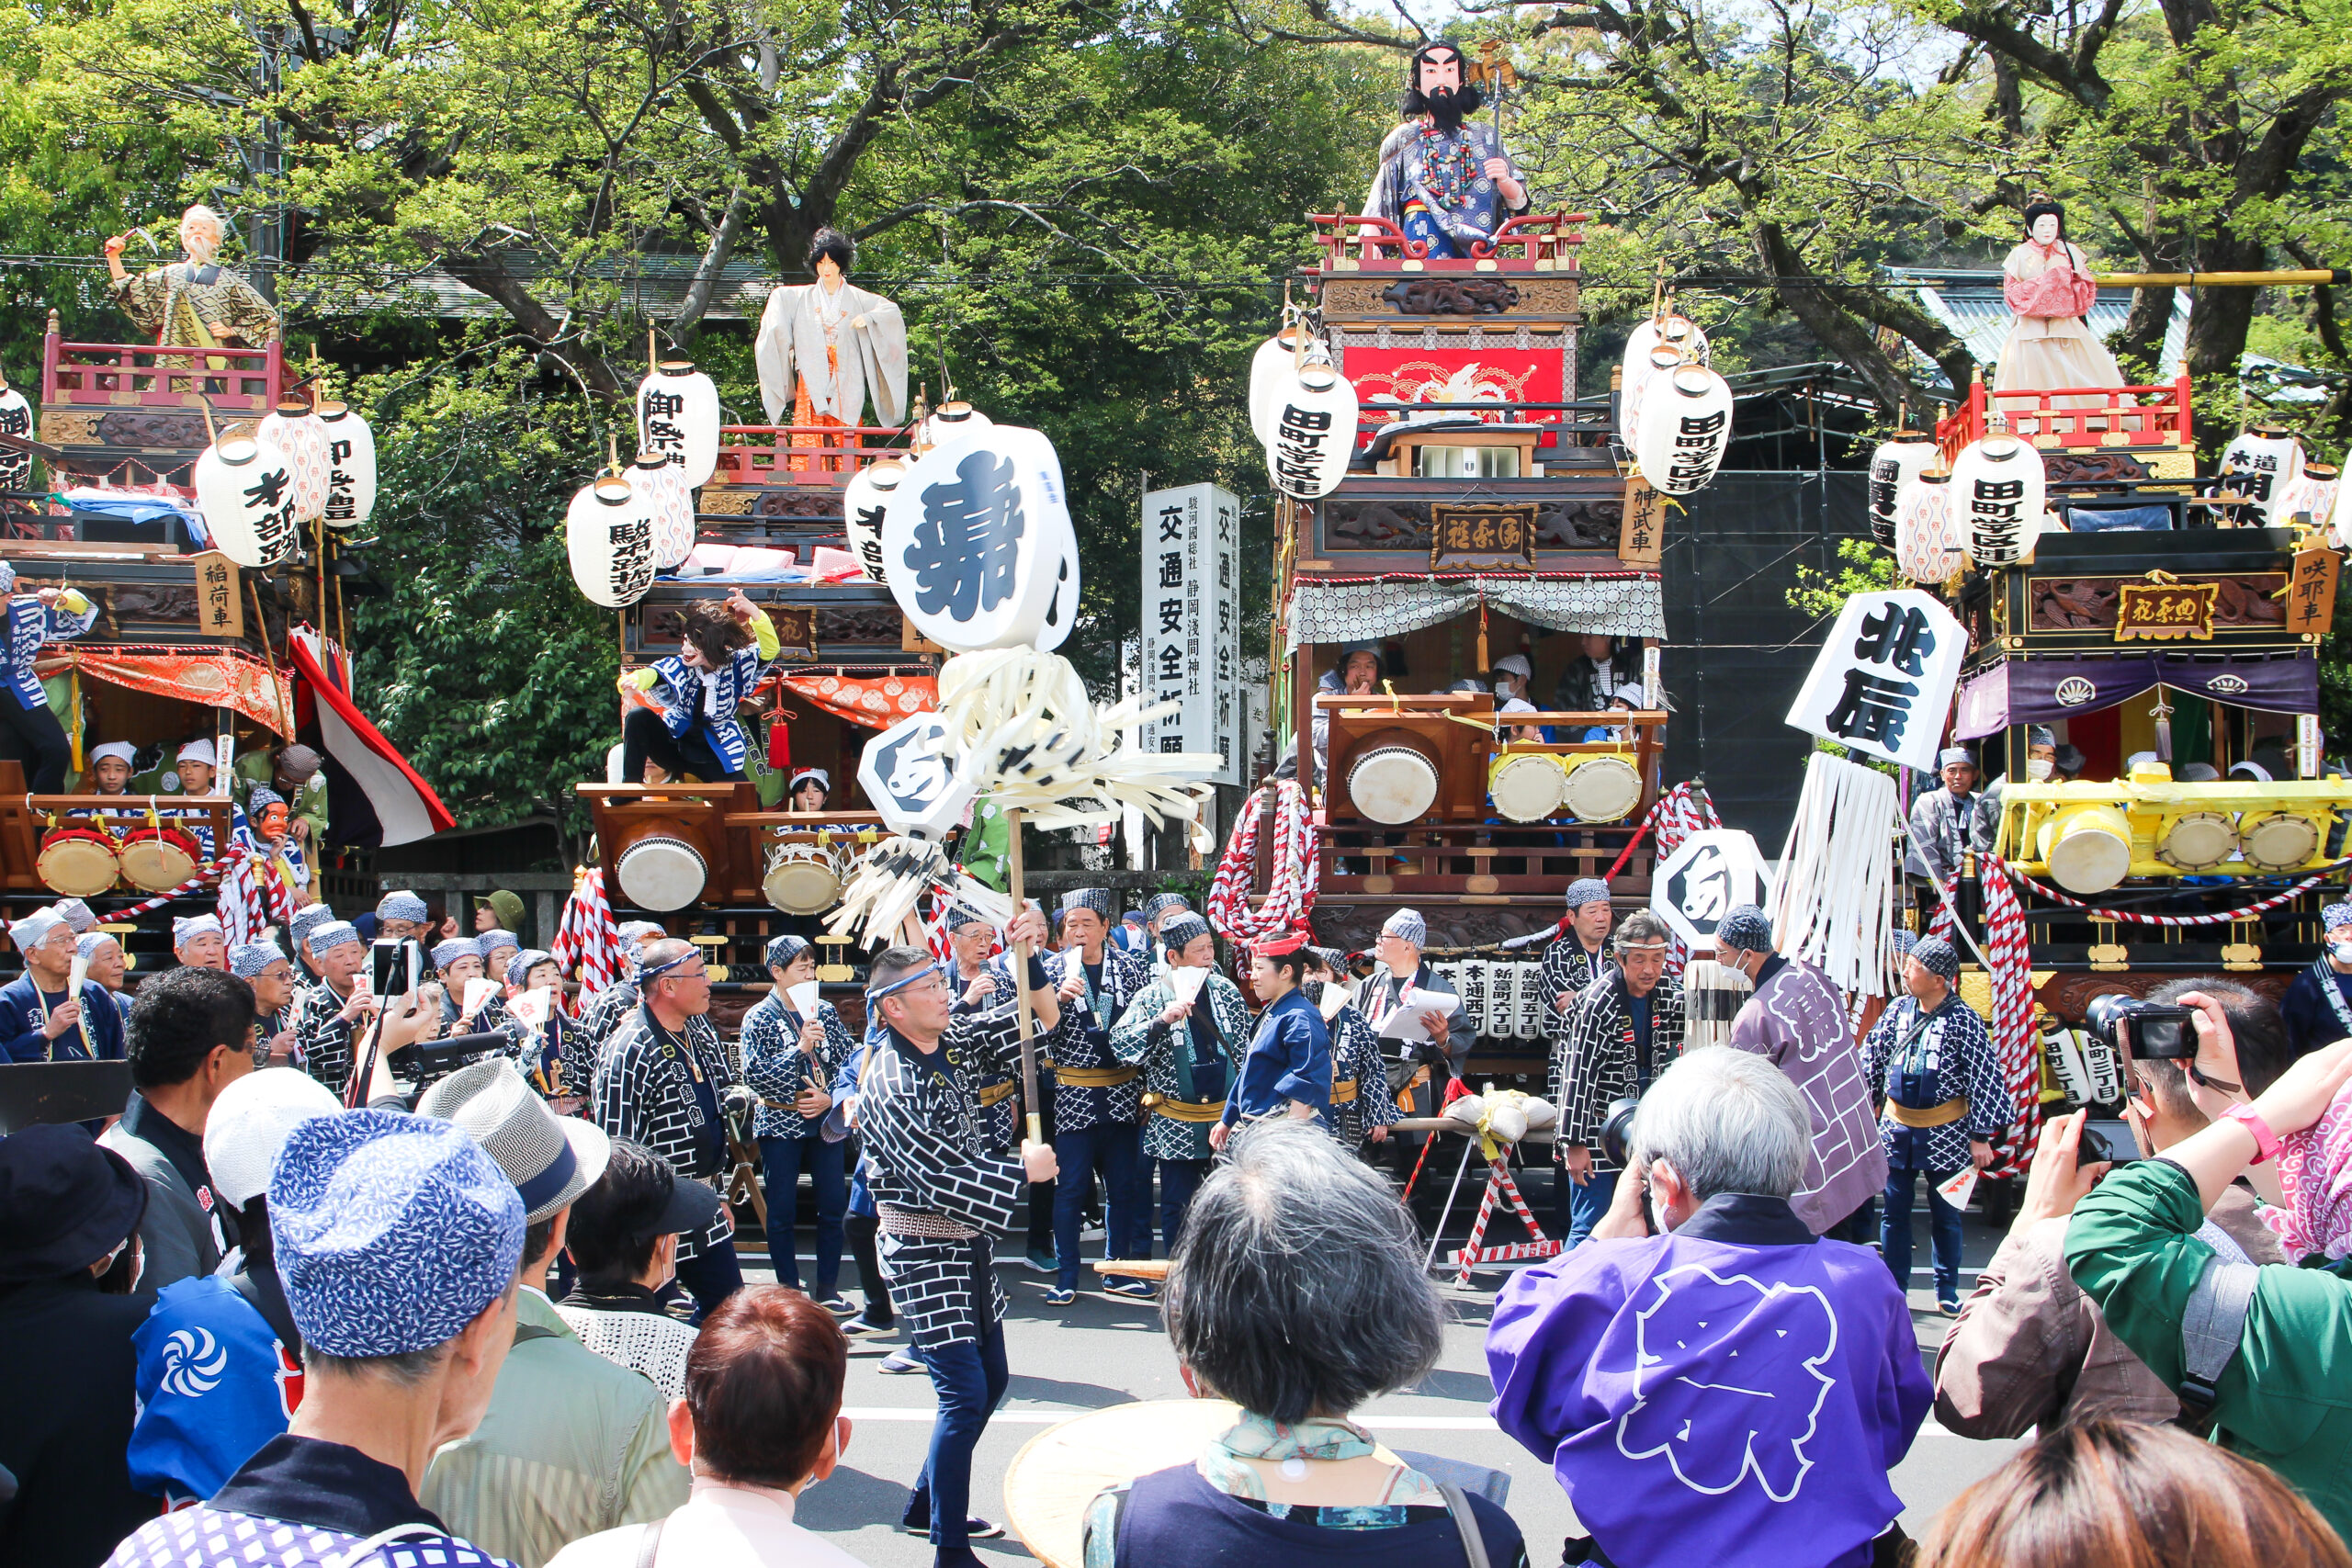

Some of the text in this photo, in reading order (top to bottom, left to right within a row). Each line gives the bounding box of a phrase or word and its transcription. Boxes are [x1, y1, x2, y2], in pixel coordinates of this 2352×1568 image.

[1277, 403, 1332, 495] 田町学区連
[1666, 411, 1725, 491] 田町学区連
[1629, 488, 1659, 553] 神武車
[1971, 479, 2024, 562] 田町学区連
[205, 564, 232, 628] 稲荷車
[2297, 558, 2330, 626] 咲耶車
[1826, 601, 1936, 753] 北辰
[1465, 964, 1485, 1031] 本通西町
[1493, 968, 1513, 1034] 新富町六丁目
[1521, 968, 1540, 1034] 新富町五丁目
[2045, 1042, 2080, 1101] 田町二丁目
[2087, 1037, 2116, 1100] 田町三丁目
